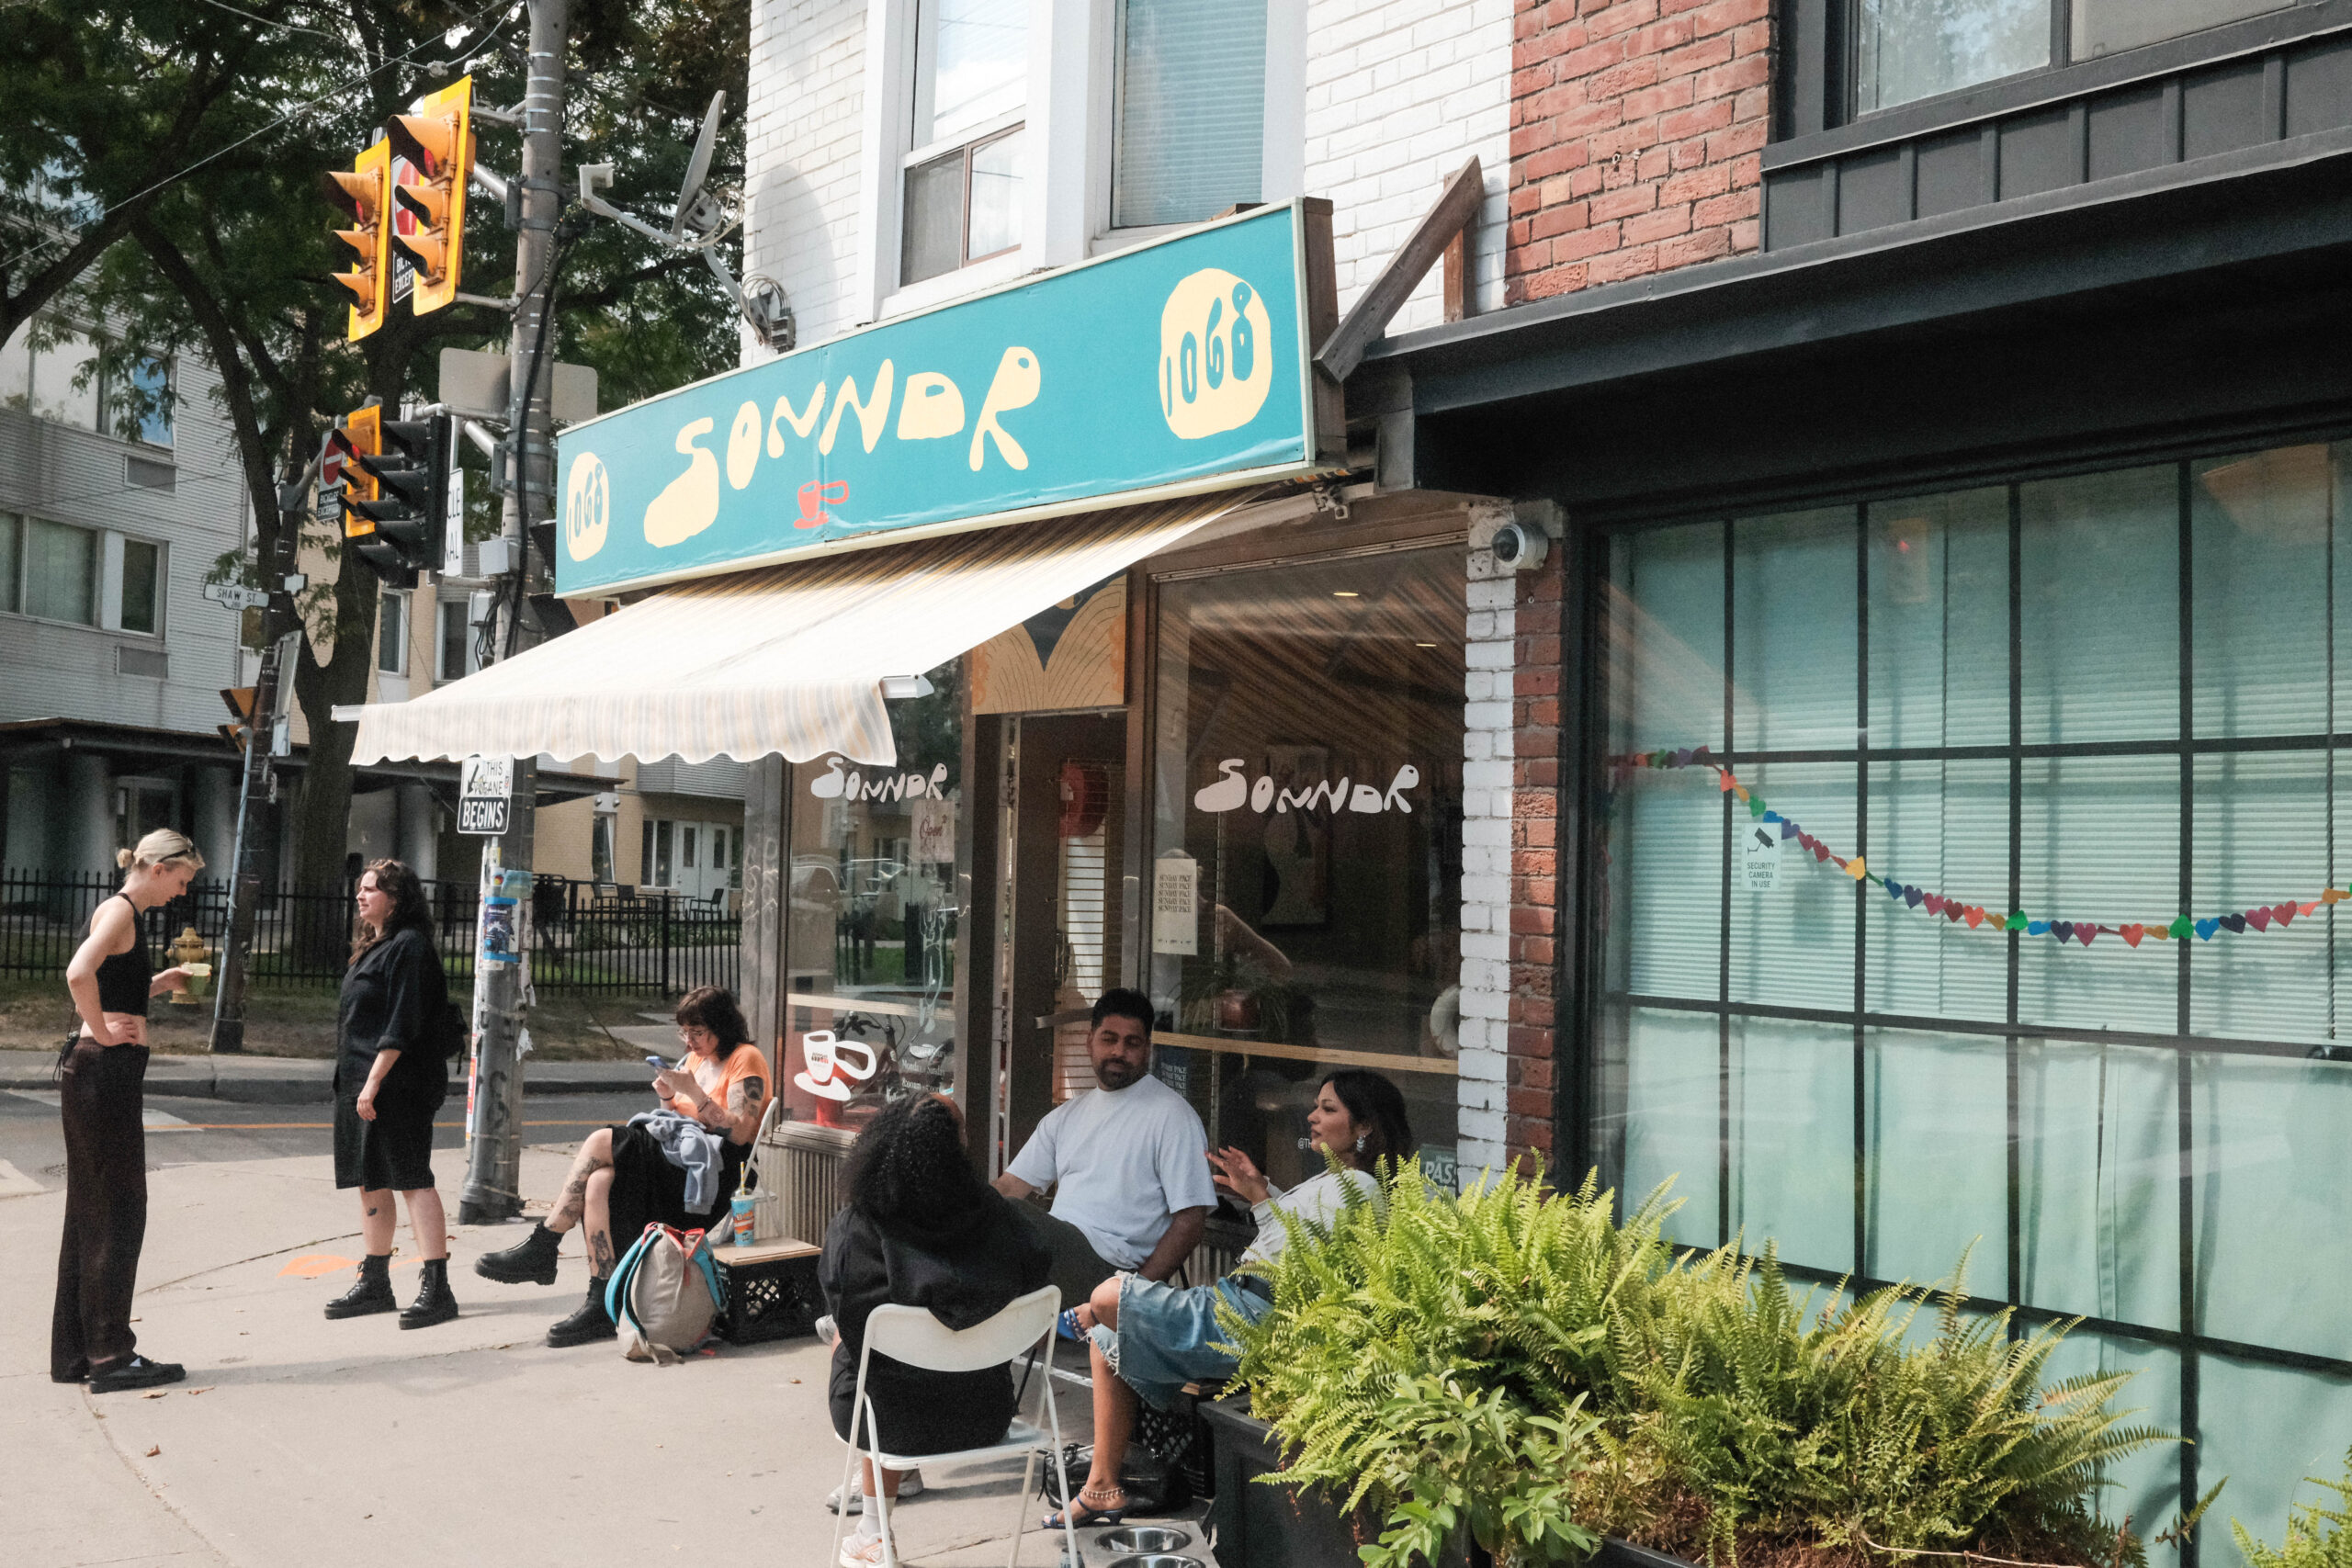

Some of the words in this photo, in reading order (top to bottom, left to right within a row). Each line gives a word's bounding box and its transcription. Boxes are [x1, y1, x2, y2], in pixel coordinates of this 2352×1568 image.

[1167, 282, 1253, 418] 1068
[644, 346, 1041, 547] SONNDR
[569, 462, 603, 545] 1068
[217, 588, 242, 600] SHAW
[486, 761, 503, 776] THIS
[811, 757, 947, 803] SONNDR
[1194, 759, 1419, 814] SONNDR
[462, 801, 504, 829] BEGINS
[1748, 871, 1773, 879] CAMERA
[1759, 880, 1770, 888] USE
